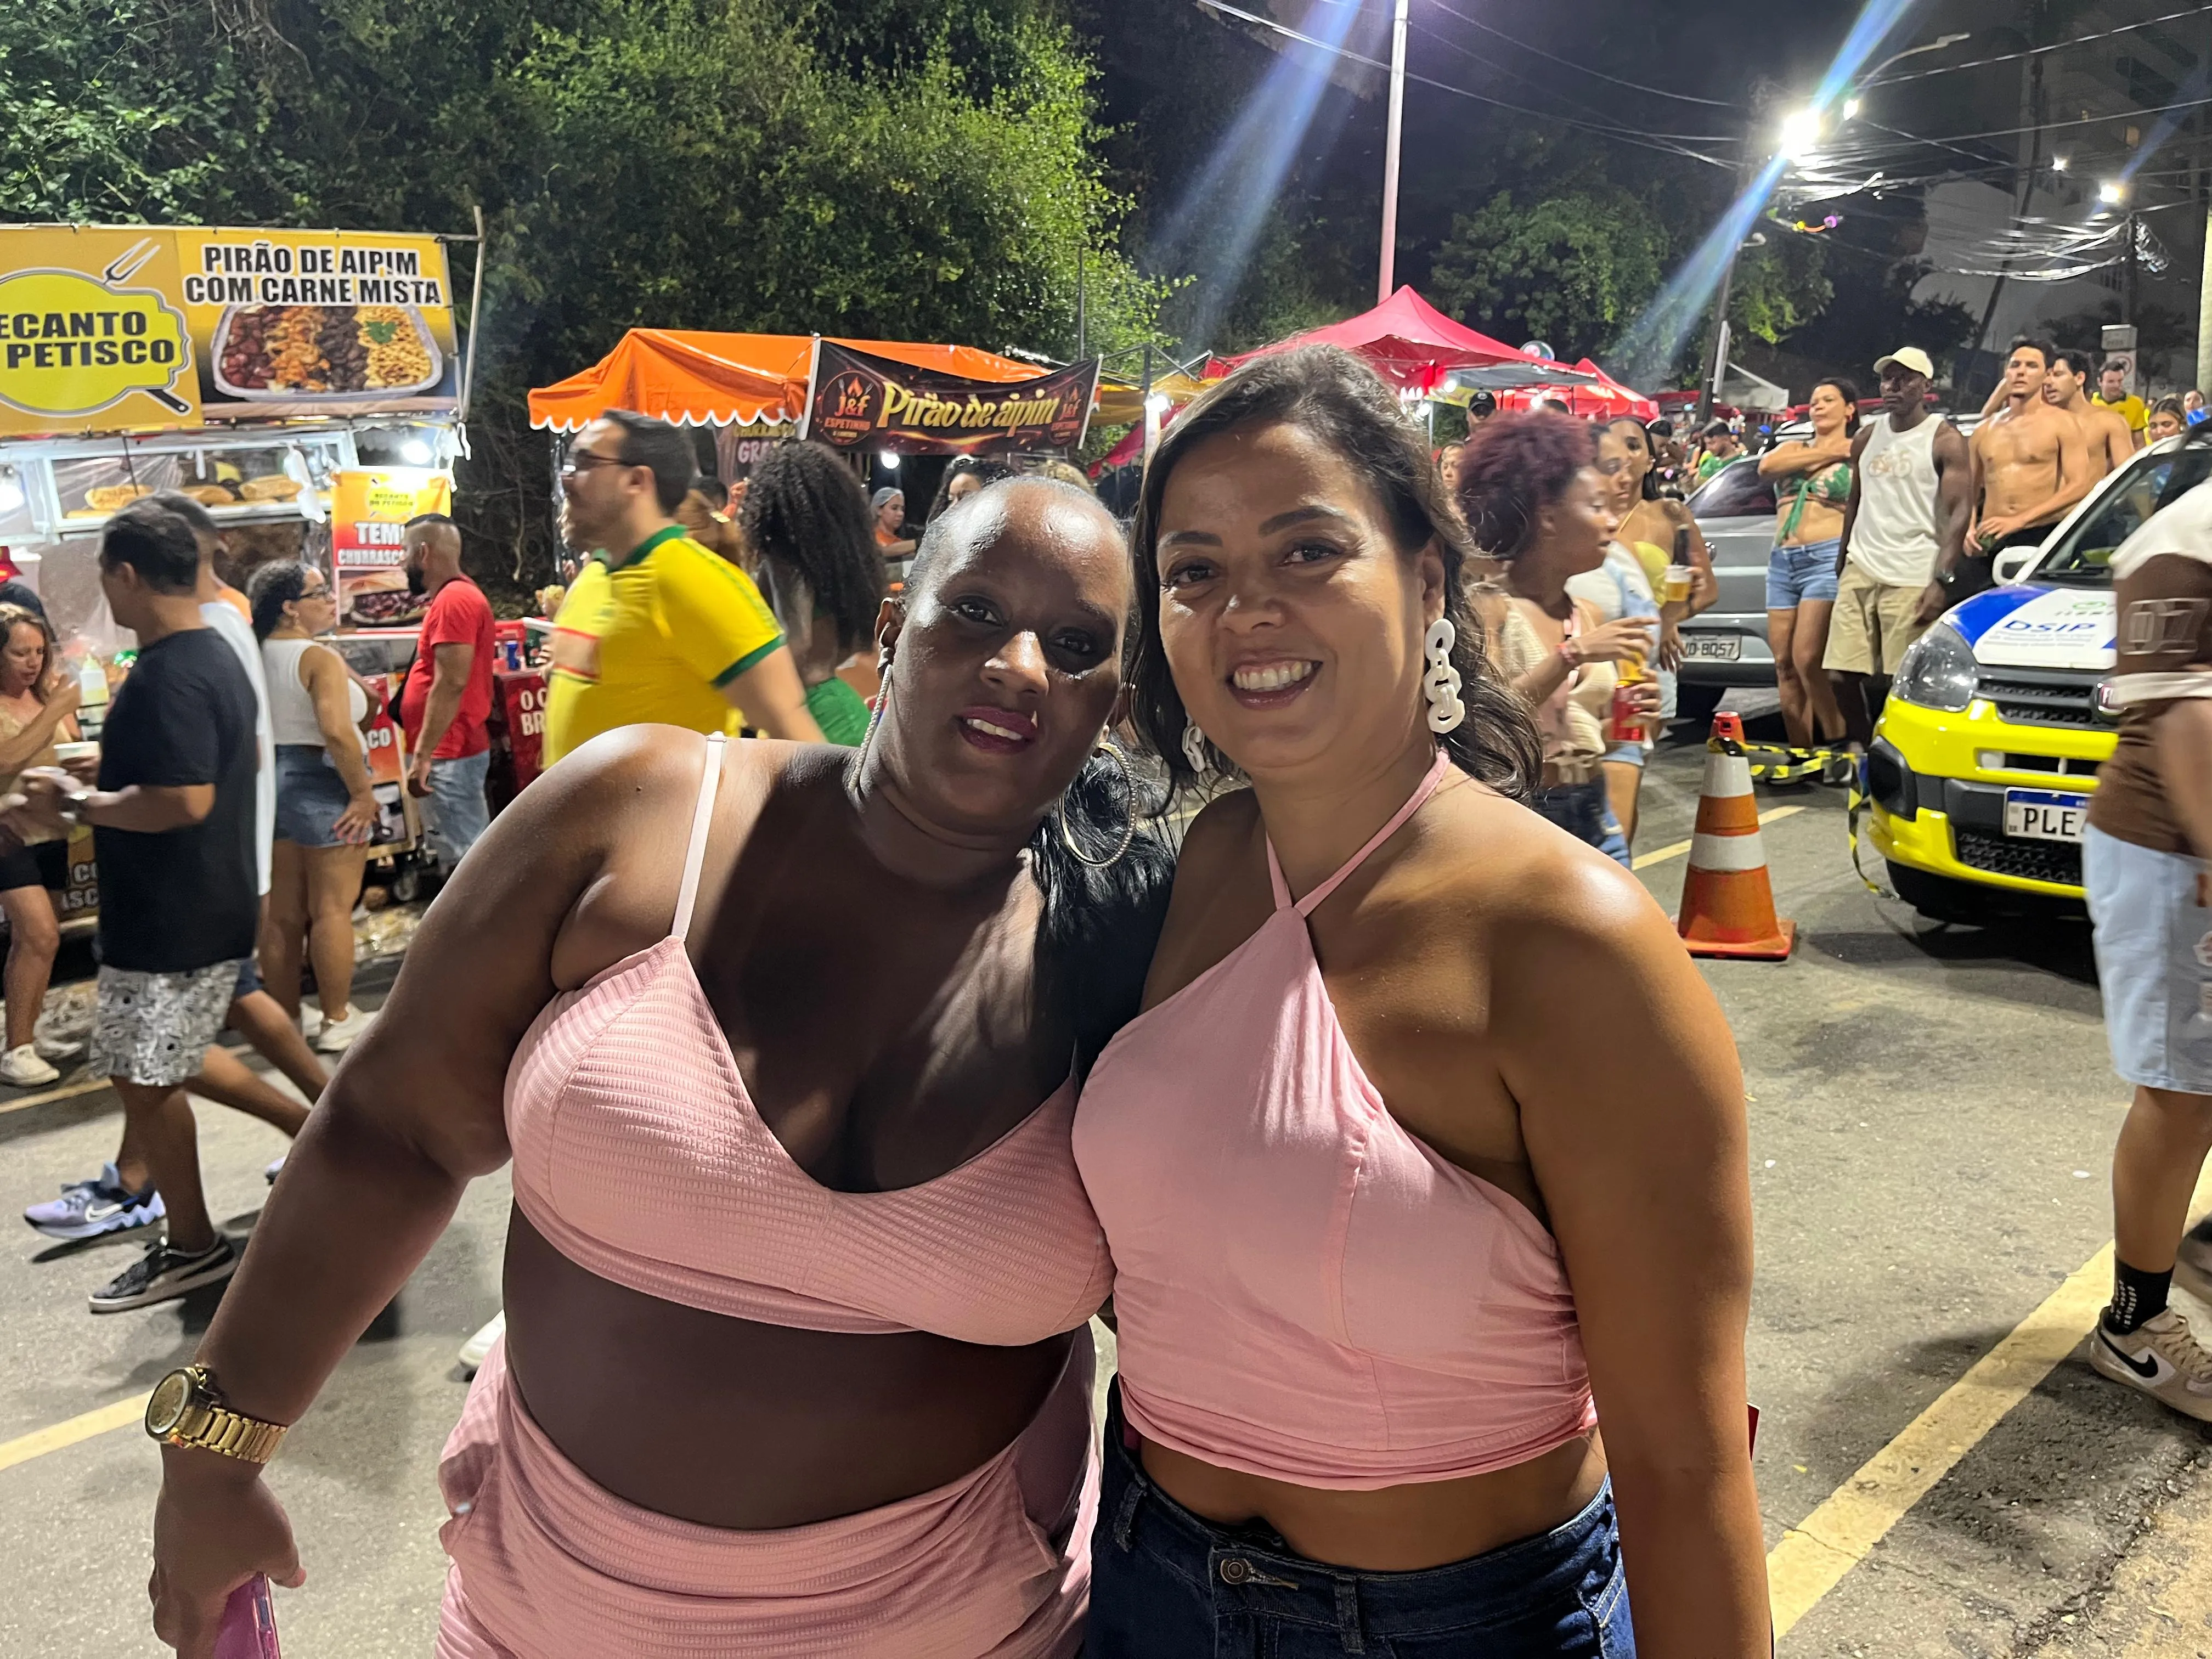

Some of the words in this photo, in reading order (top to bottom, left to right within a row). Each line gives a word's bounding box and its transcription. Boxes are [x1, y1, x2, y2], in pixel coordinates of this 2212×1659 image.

[204, 242, 291, 273] PIRÃO
[301, 249, 334, 274] DE
[341, 249, 418, 275] AIPIM
[185, 276, 252, 303] COM
[261, 278, 352, 303] CARNE
[360, 280, 440, 304] MISTA
[7, 339, 174, 369] PETISCO
[876, 381, 962, 428] Pirão
[960, 393, 997, 428] de
[992, 388, 1060, 438] aipim
[2023, 808, 2085, 837] PLE
